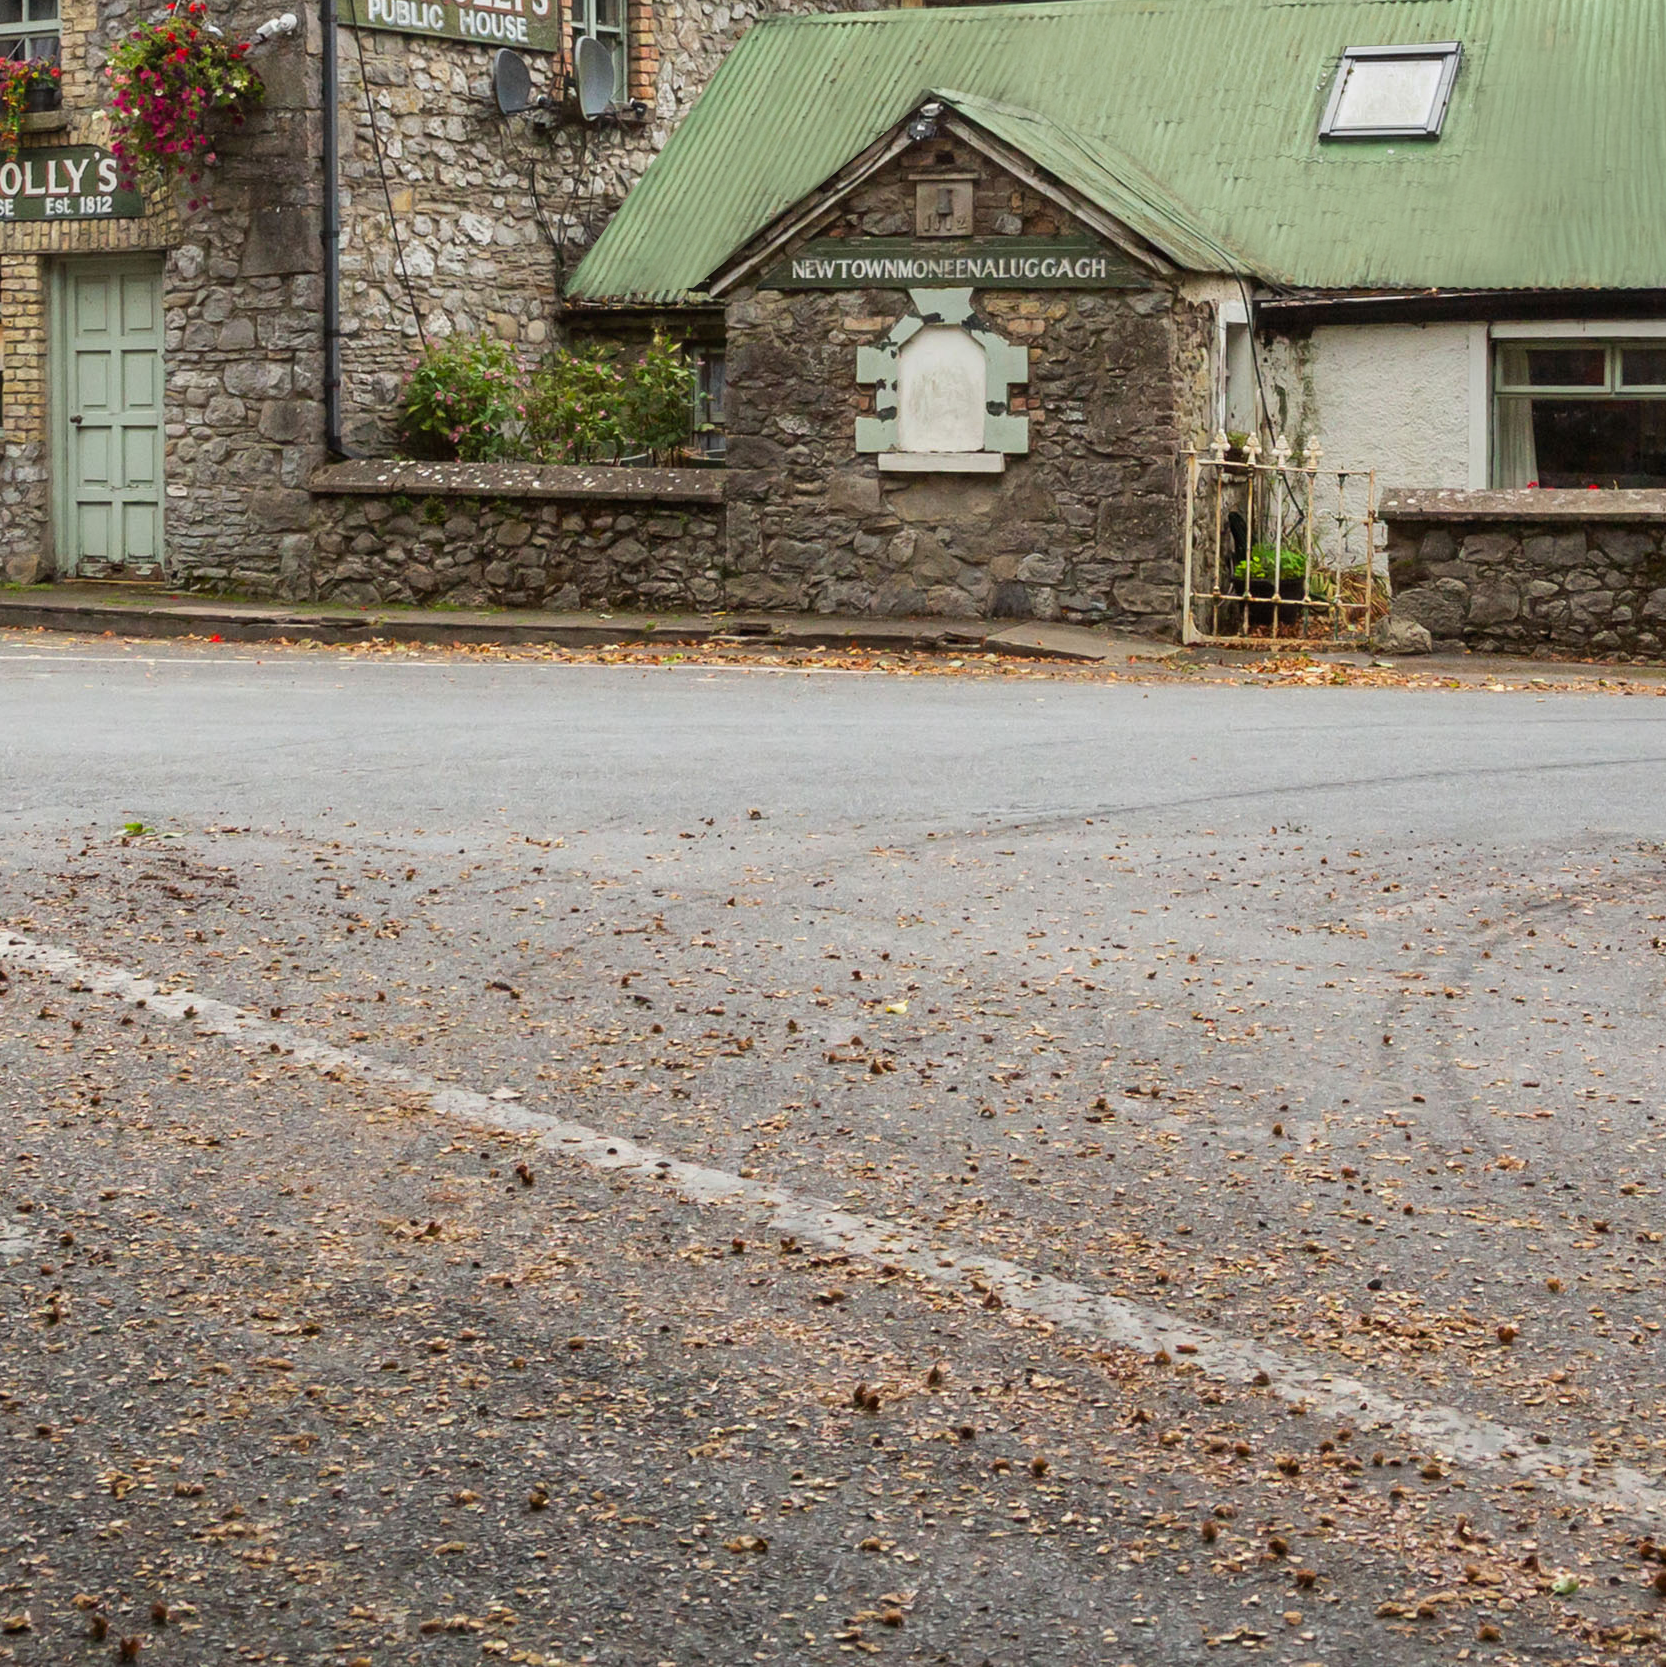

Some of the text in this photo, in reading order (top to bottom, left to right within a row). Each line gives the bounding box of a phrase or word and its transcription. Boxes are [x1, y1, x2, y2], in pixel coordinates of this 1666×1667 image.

[459, 9, 529, 43] HOUSE
[45, 197, 74, 216] Est.
[79, 195, 113, 214] 1812
[791, 256, 1107, 280] NEWTOWNMONEENALUGGAGH
